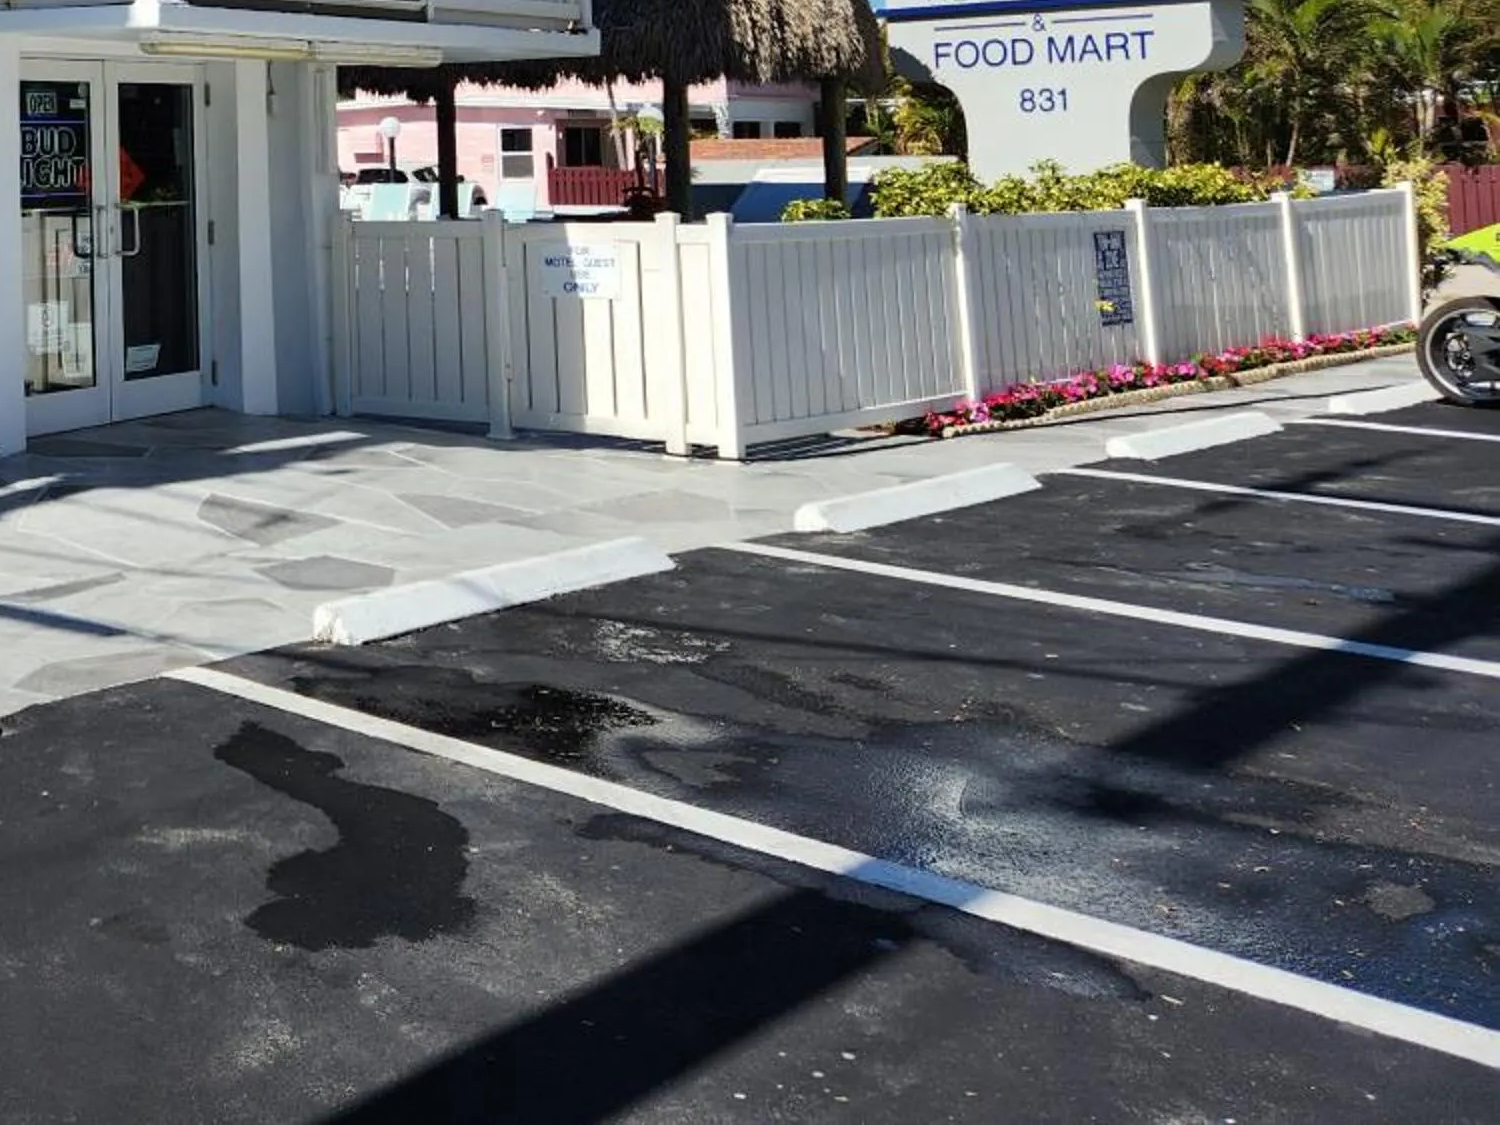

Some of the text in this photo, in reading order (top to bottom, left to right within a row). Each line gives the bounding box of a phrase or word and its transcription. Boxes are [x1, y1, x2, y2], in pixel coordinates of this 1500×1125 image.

[1032, 13, 1046, 32] &
[933, 30, 1155, 69] FOOD MART
[1019, 88, 1068, 113] 831
[21, 126, 76, 157] BUD
[20, 157, 85, 188] IGHT
[563, 281, 600, 293] ONLY
